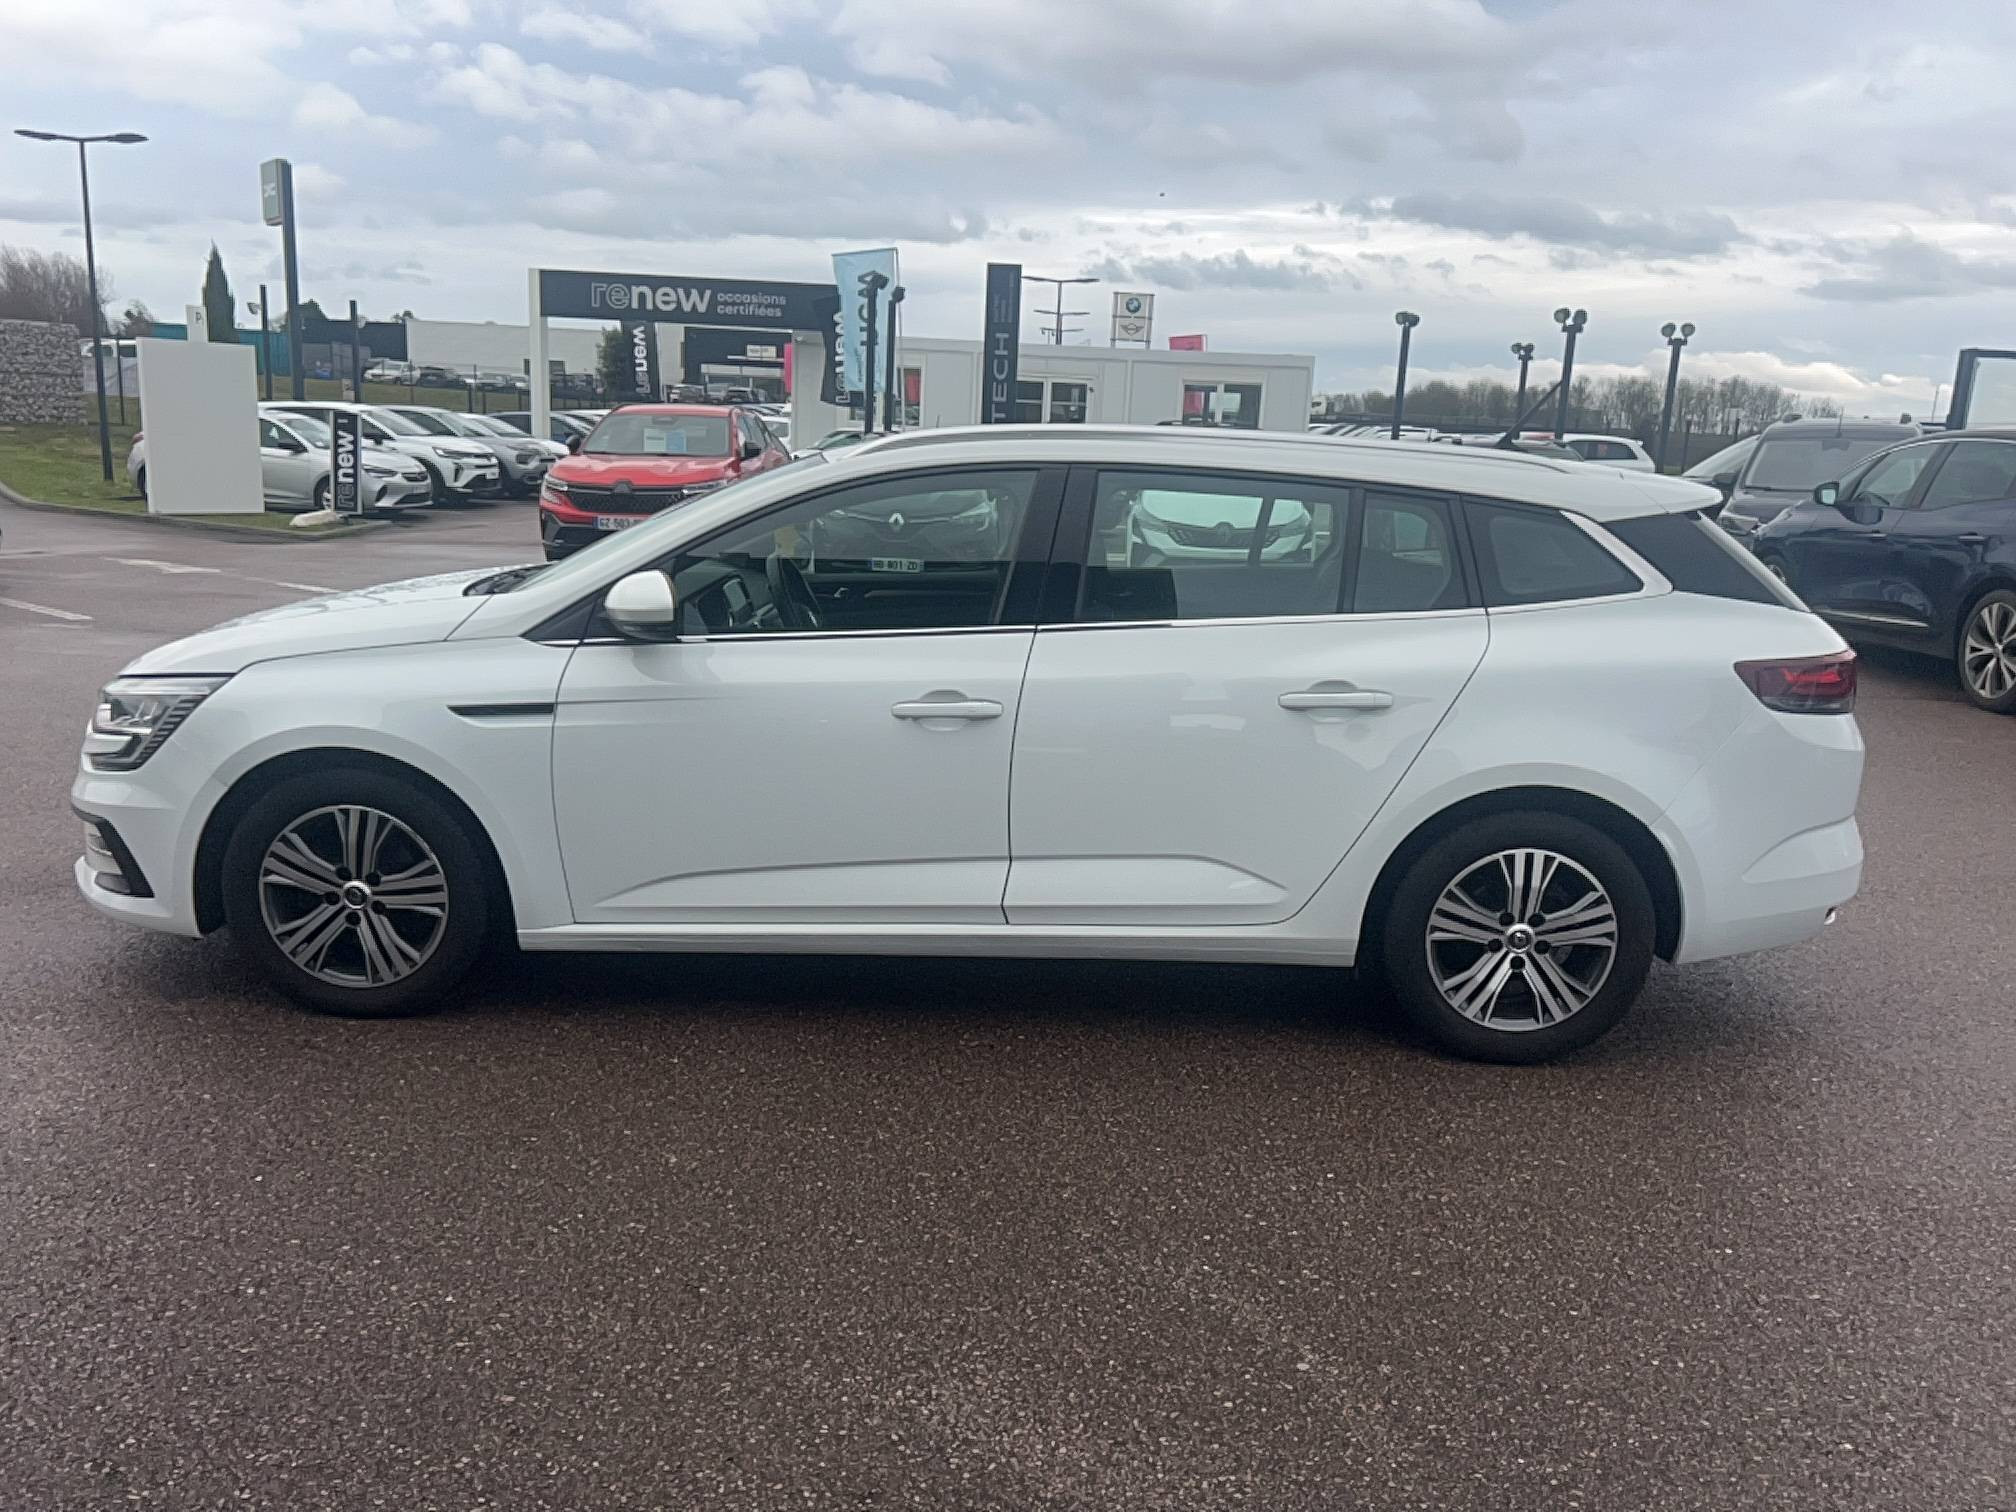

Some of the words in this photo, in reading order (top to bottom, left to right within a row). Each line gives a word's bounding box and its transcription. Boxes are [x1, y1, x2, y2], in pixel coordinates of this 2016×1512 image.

[591, 282, 712, 313] renew
[716, 291, 787, 305] occasions
[336, 430, 355, 508] renew
